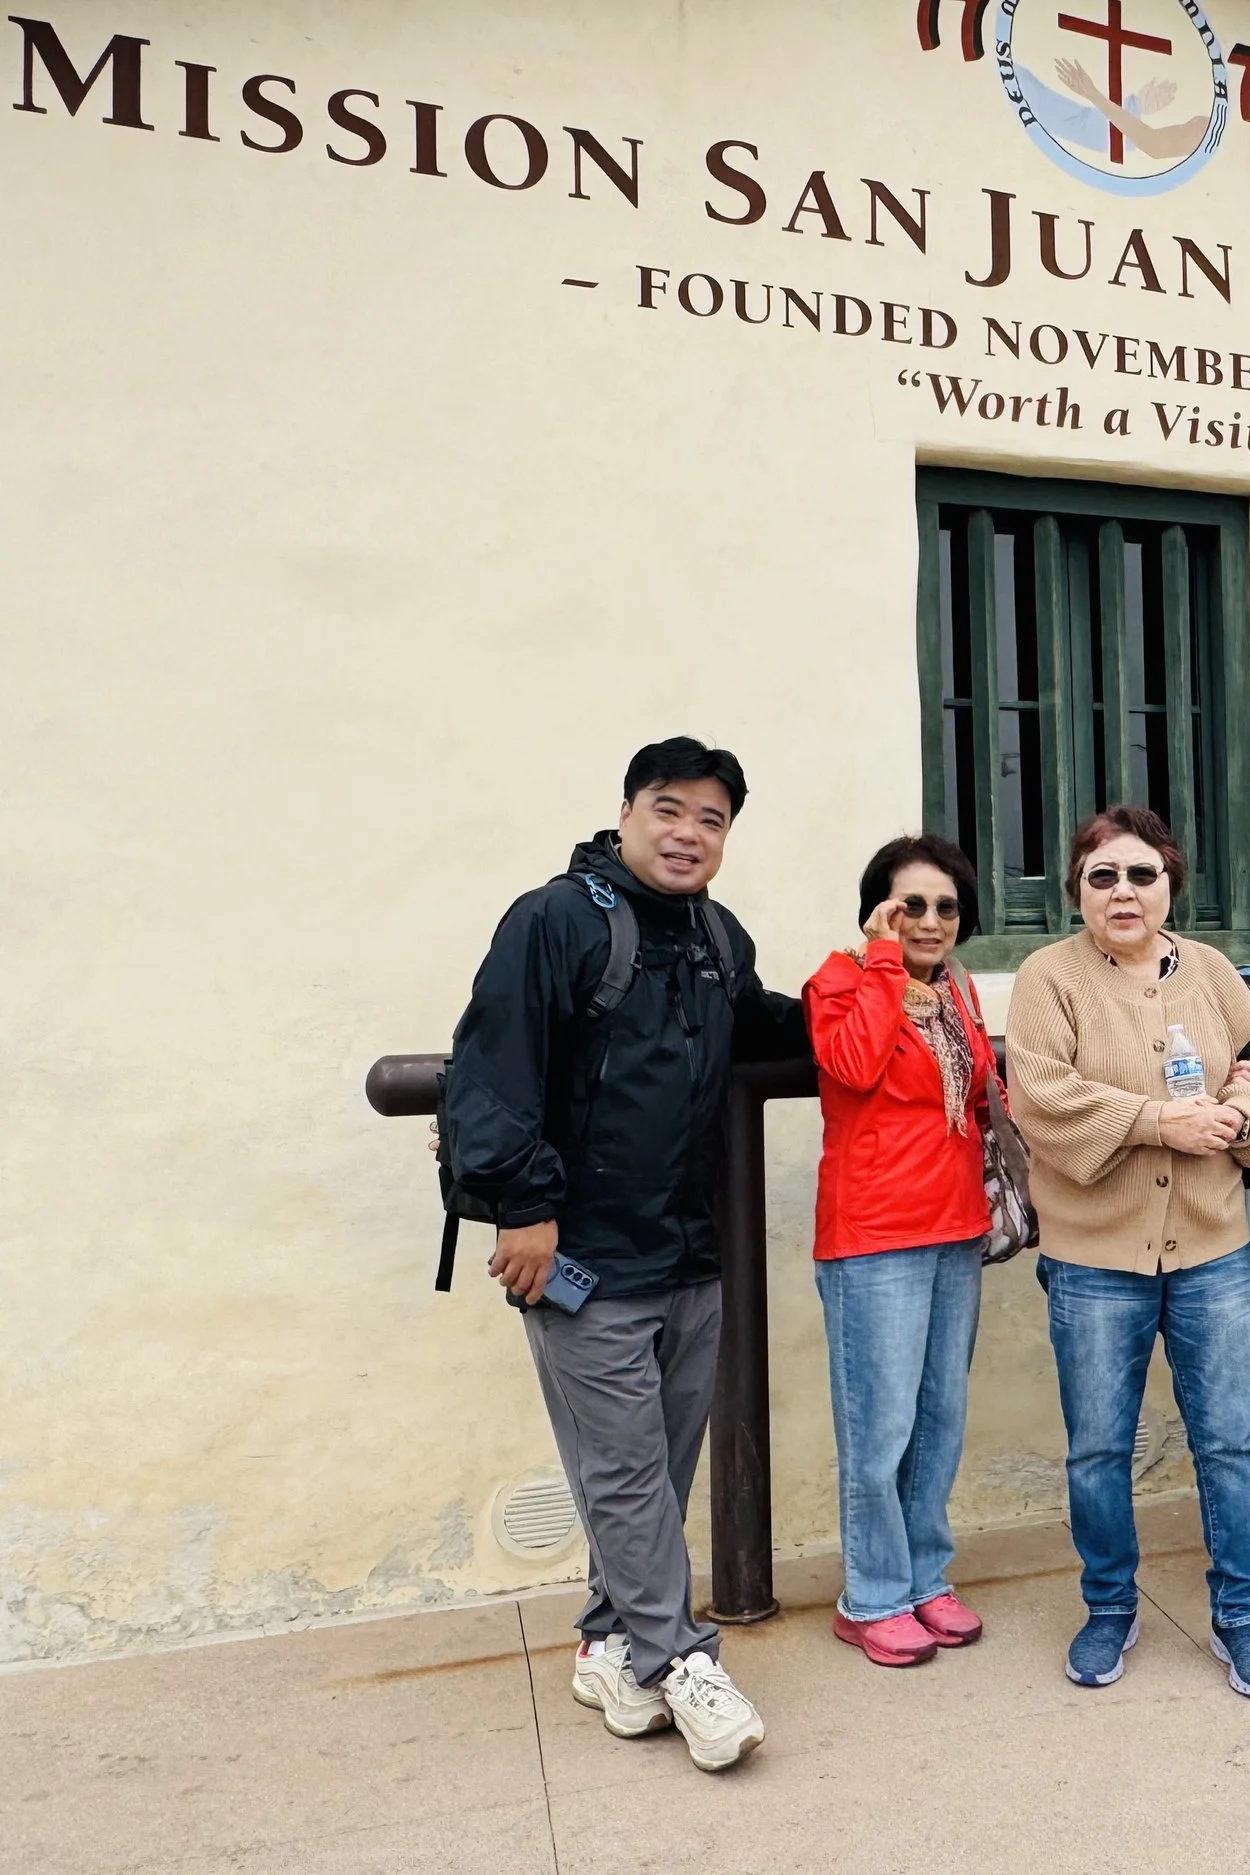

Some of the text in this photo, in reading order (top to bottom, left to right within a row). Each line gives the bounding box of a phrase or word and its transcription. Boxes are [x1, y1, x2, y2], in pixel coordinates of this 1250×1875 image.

[7, 14, 644, 209] MISSION
[704, 139, 932, 256] SAN
[964, 187, 1234, 305] JUAN
[635, 264, 958, 349] FOUNDED
[1103, 408, 1132, 436] a
